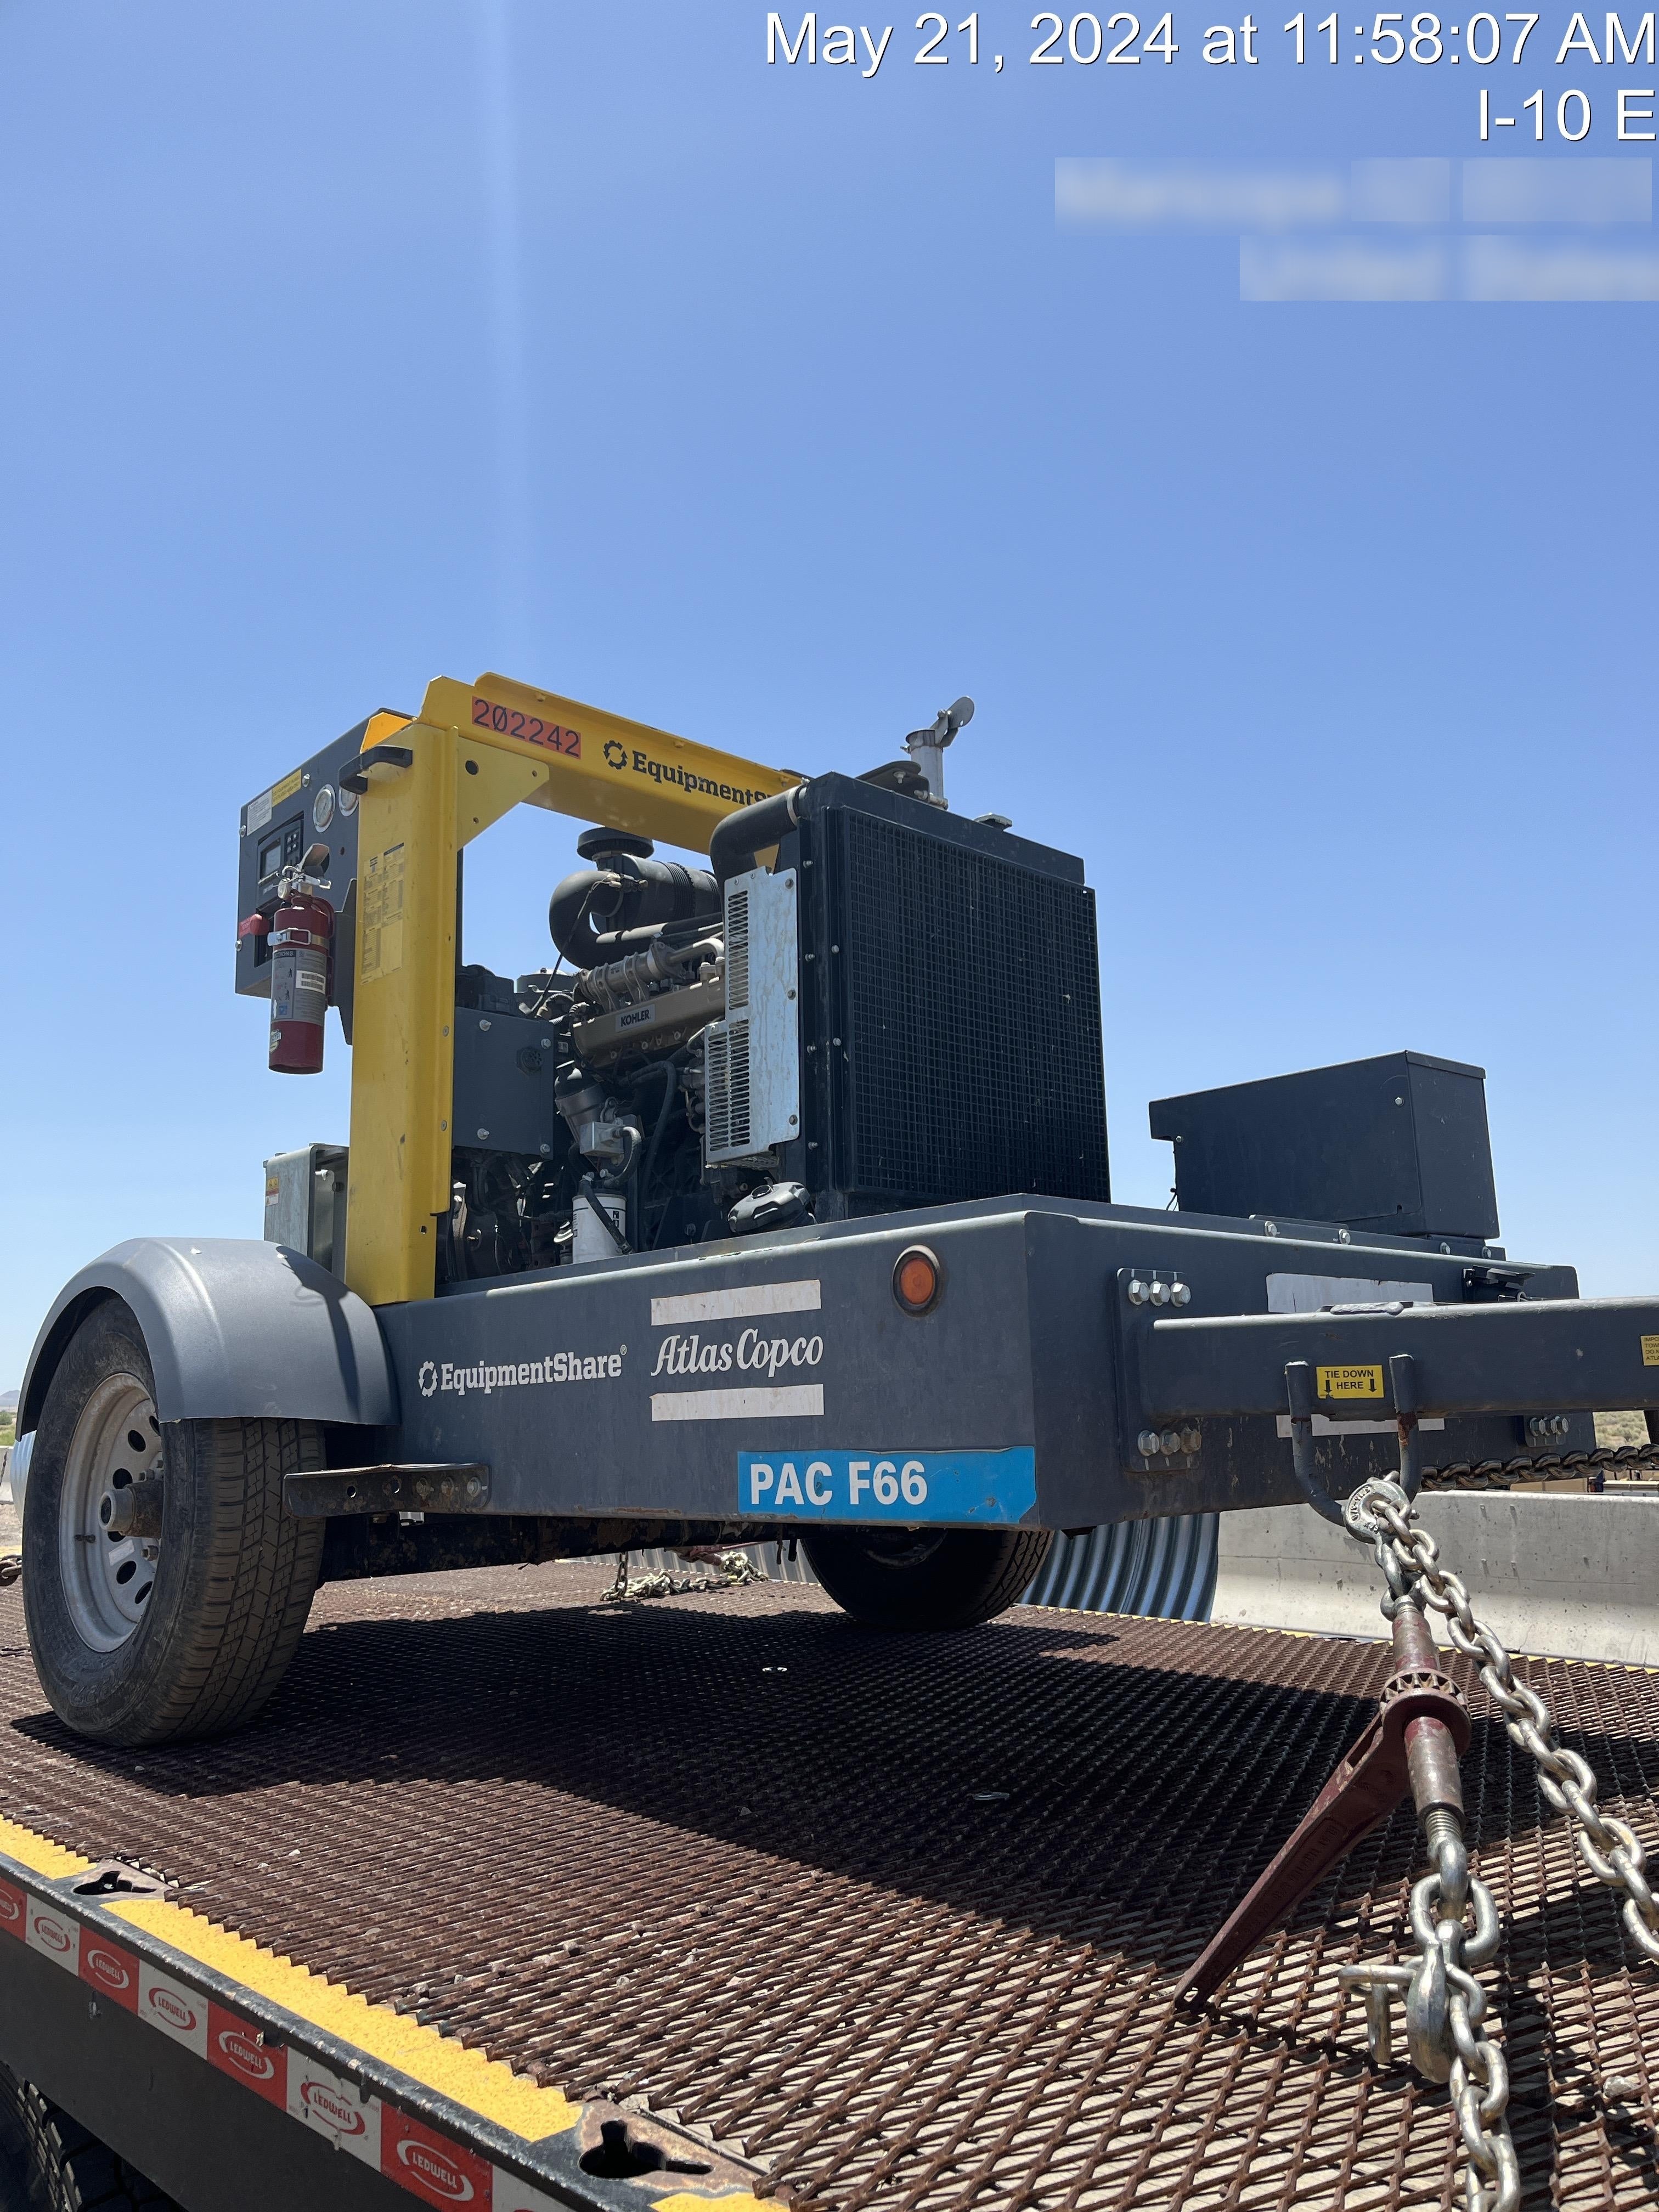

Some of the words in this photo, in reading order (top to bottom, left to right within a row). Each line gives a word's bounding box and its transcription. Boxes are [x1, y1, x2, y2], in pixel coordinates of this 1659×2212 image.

[473, 699, 579, 758] 202242
[620, 1009, 650, 1028] KOHLER
[1336, 1381, 1364, 1390] HERE
[1343, 1369, 1374, 1378] DOWN
[750, 1461, 833, 1506] PAC
[849, 1460, 928, 1505] F66
[95, 1958, 121, 1981] LEDWELL
[157, 1995, 186, 2021] LEDWELL
[229, 2040, 263, 2070] LEDWELL
[313, 2091, 352, 2125] LEDWELL
[411, 2151, 458, 2190] LEDWELL
